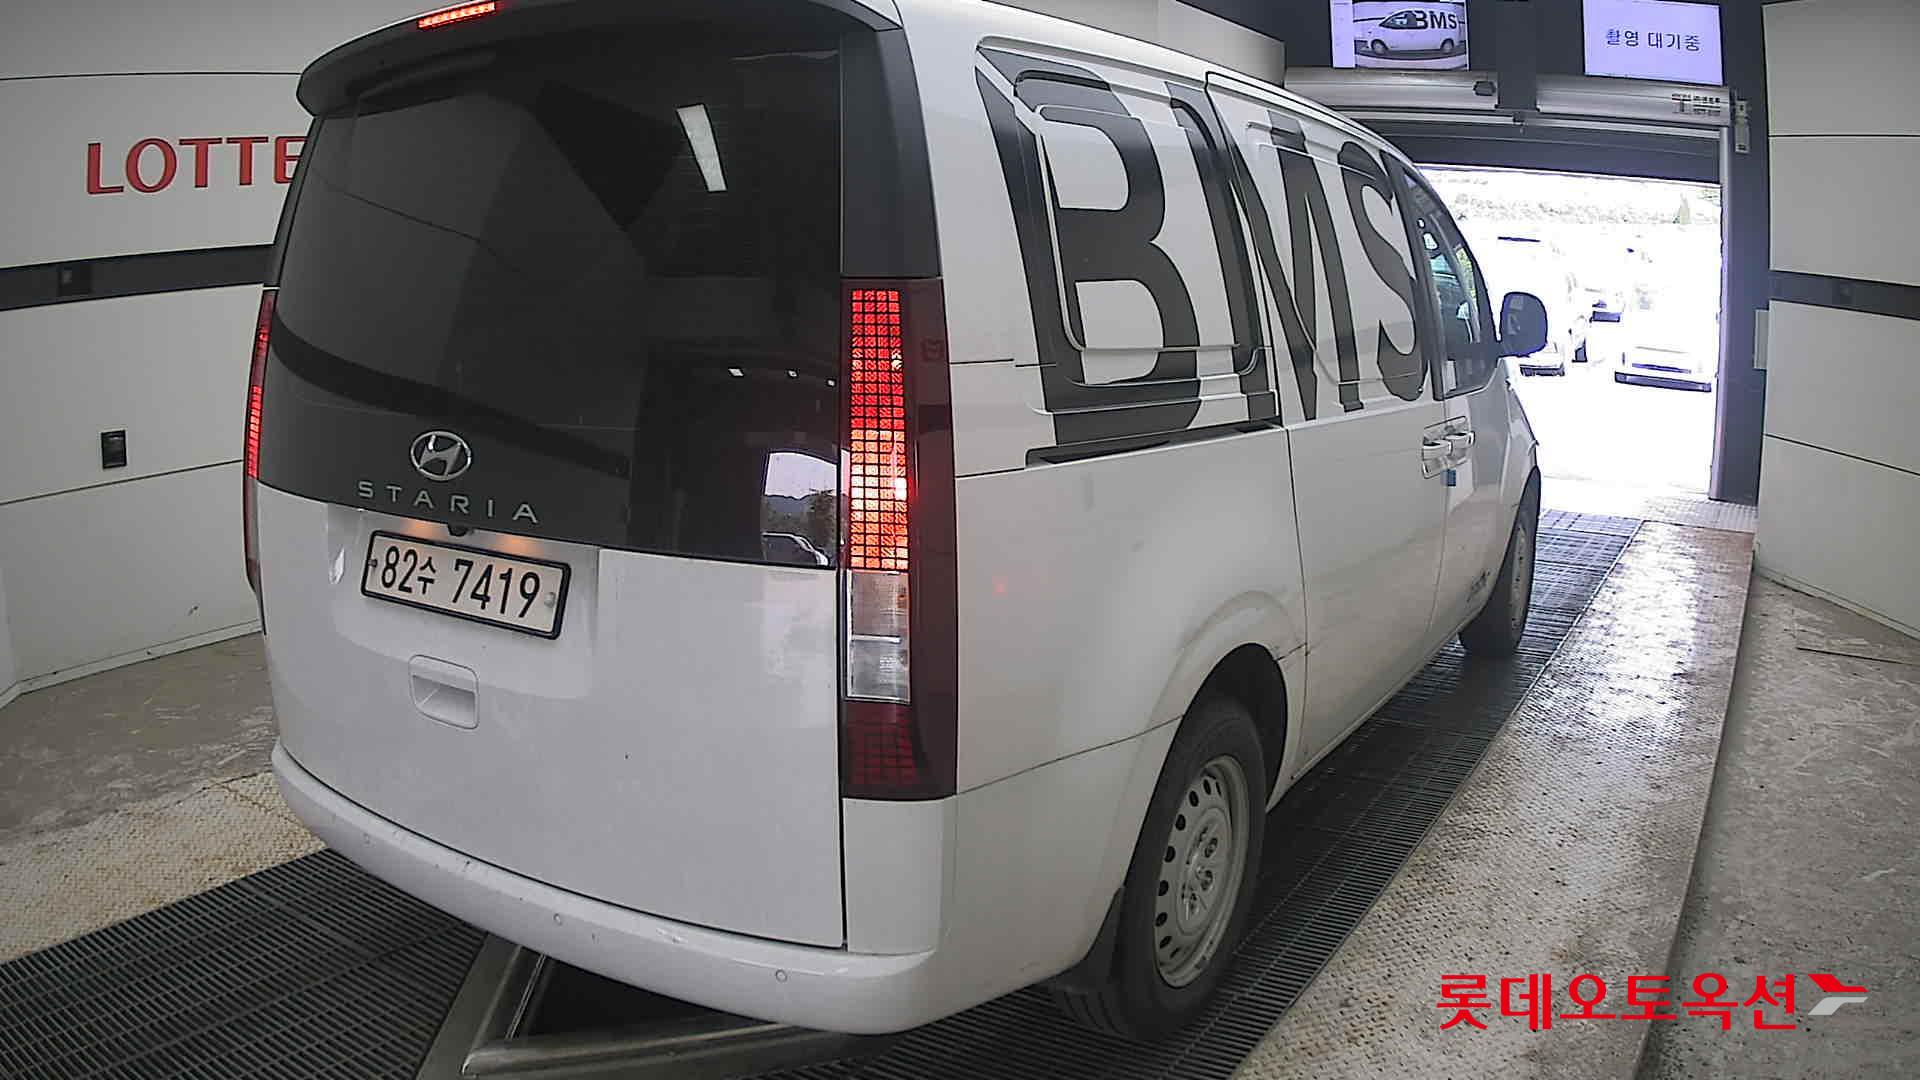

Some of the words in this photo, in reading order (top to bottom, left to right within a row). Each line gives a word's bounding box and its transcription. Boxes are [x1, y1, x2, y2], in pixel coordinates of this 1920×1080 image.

[1409, 9, 1458, 30] BMS
[1647, 32, 1701, 52] 대기중
[87, 136, 308, 195] LOTTE
[975, 50, 1429, 446] BMS
[357, 480, 539, 524] STARIA
[380, 546, 437, 595] 82수
[452, 558, 541, 618] 7419
